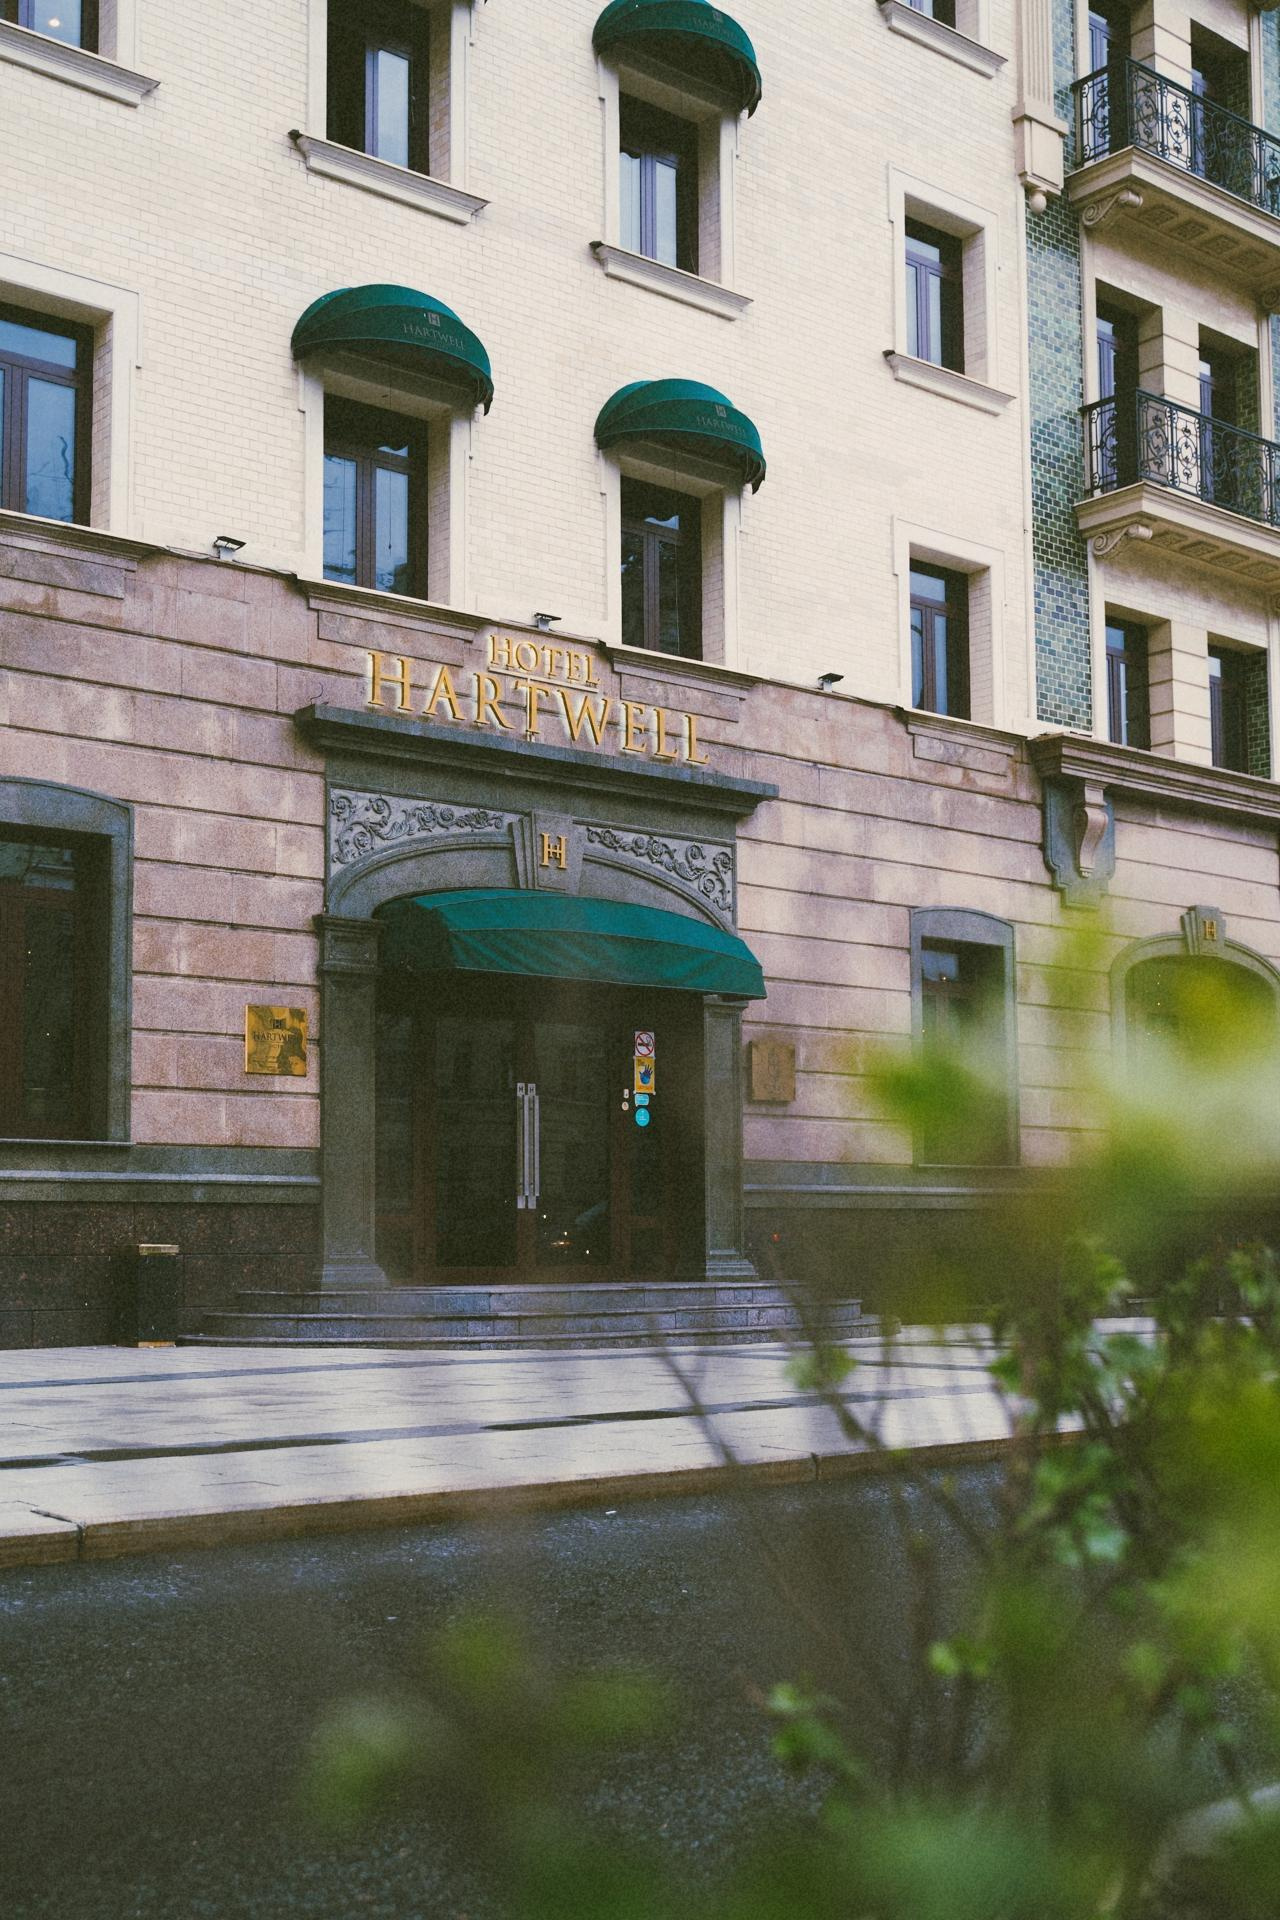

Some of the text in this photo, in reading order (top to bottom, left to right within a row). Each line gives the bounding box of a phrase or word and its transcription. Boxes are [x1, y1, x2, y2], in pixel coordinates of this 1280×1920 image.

[402, 323, 465, 351] HARTWELL
[488, 634, 601, 686] HOTEL
[367, 651, 711, 764] HARTWELL
